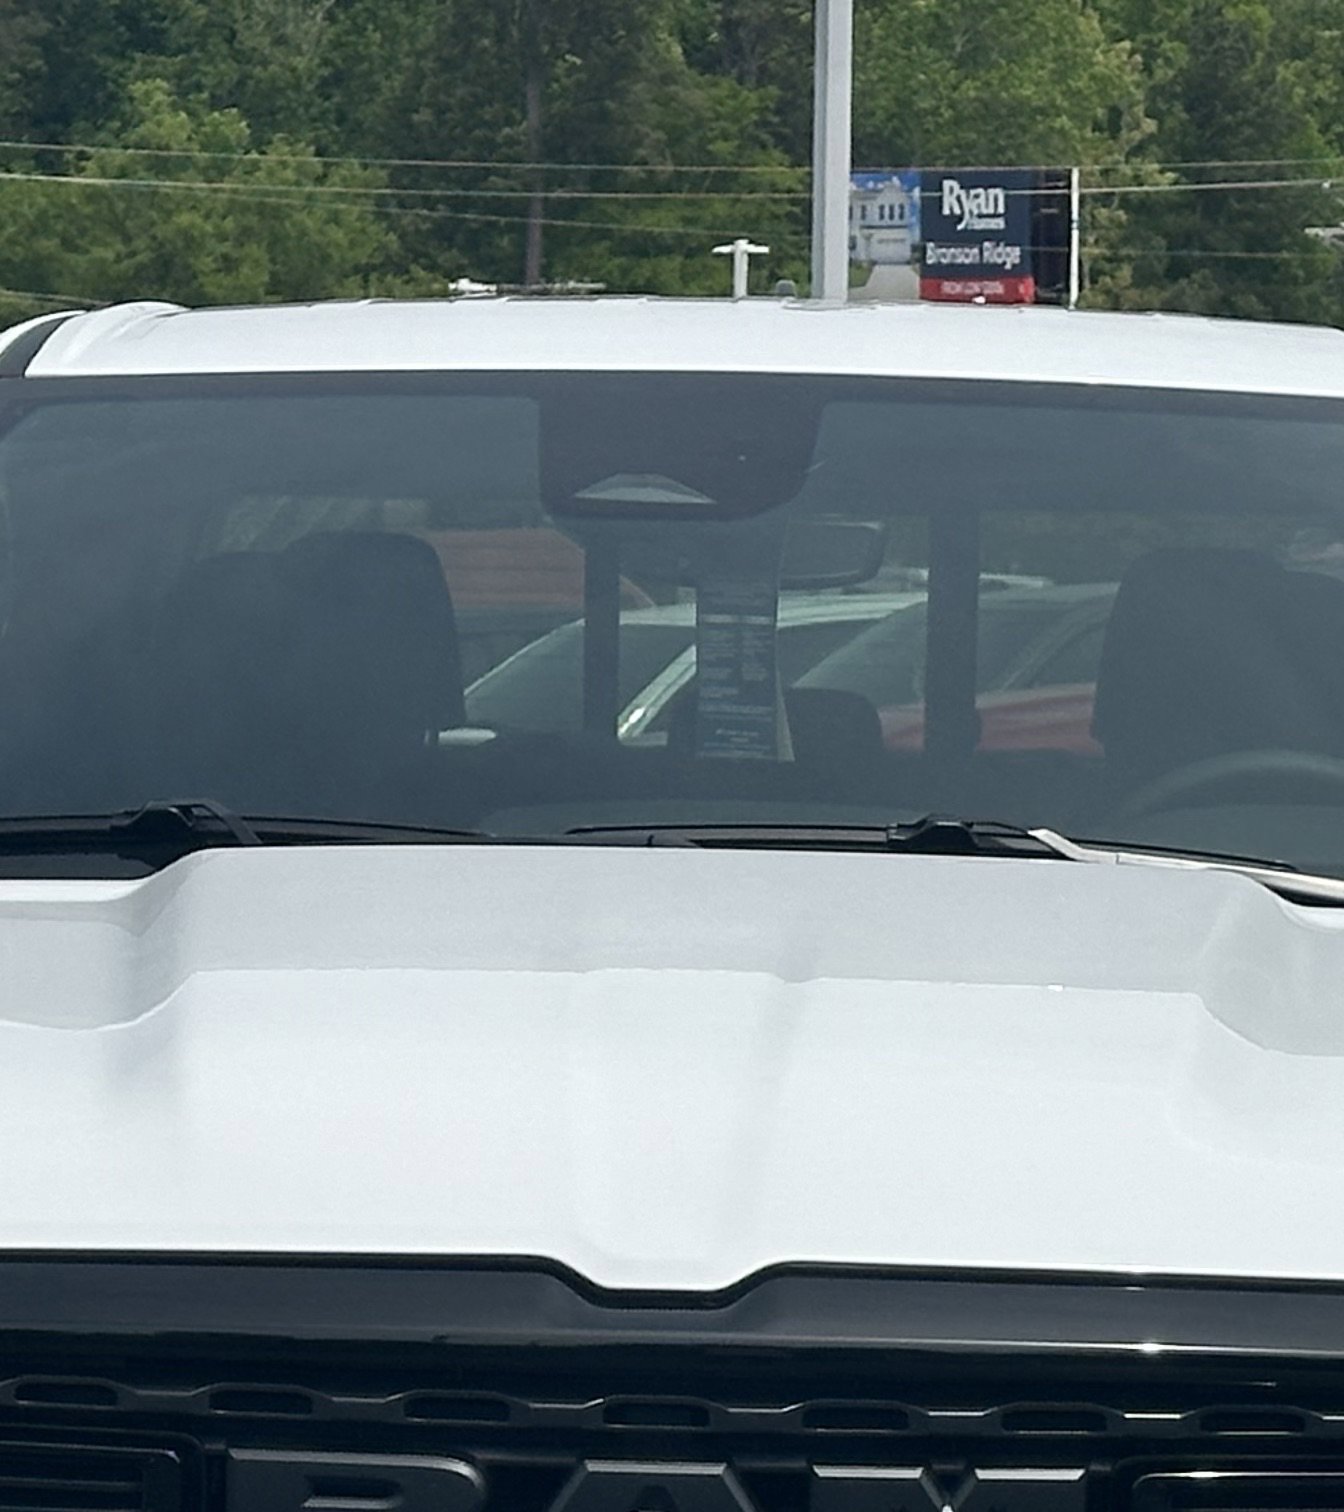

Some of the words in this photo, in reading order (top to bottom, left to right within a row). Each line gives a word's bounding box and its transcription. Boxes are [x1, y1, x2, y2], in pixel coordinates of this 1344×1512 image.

[942, 179, 1005, 230] Ryan
[926, 241, 980, 264] Bronson
[982, 241, 1021, 269] Ridge
